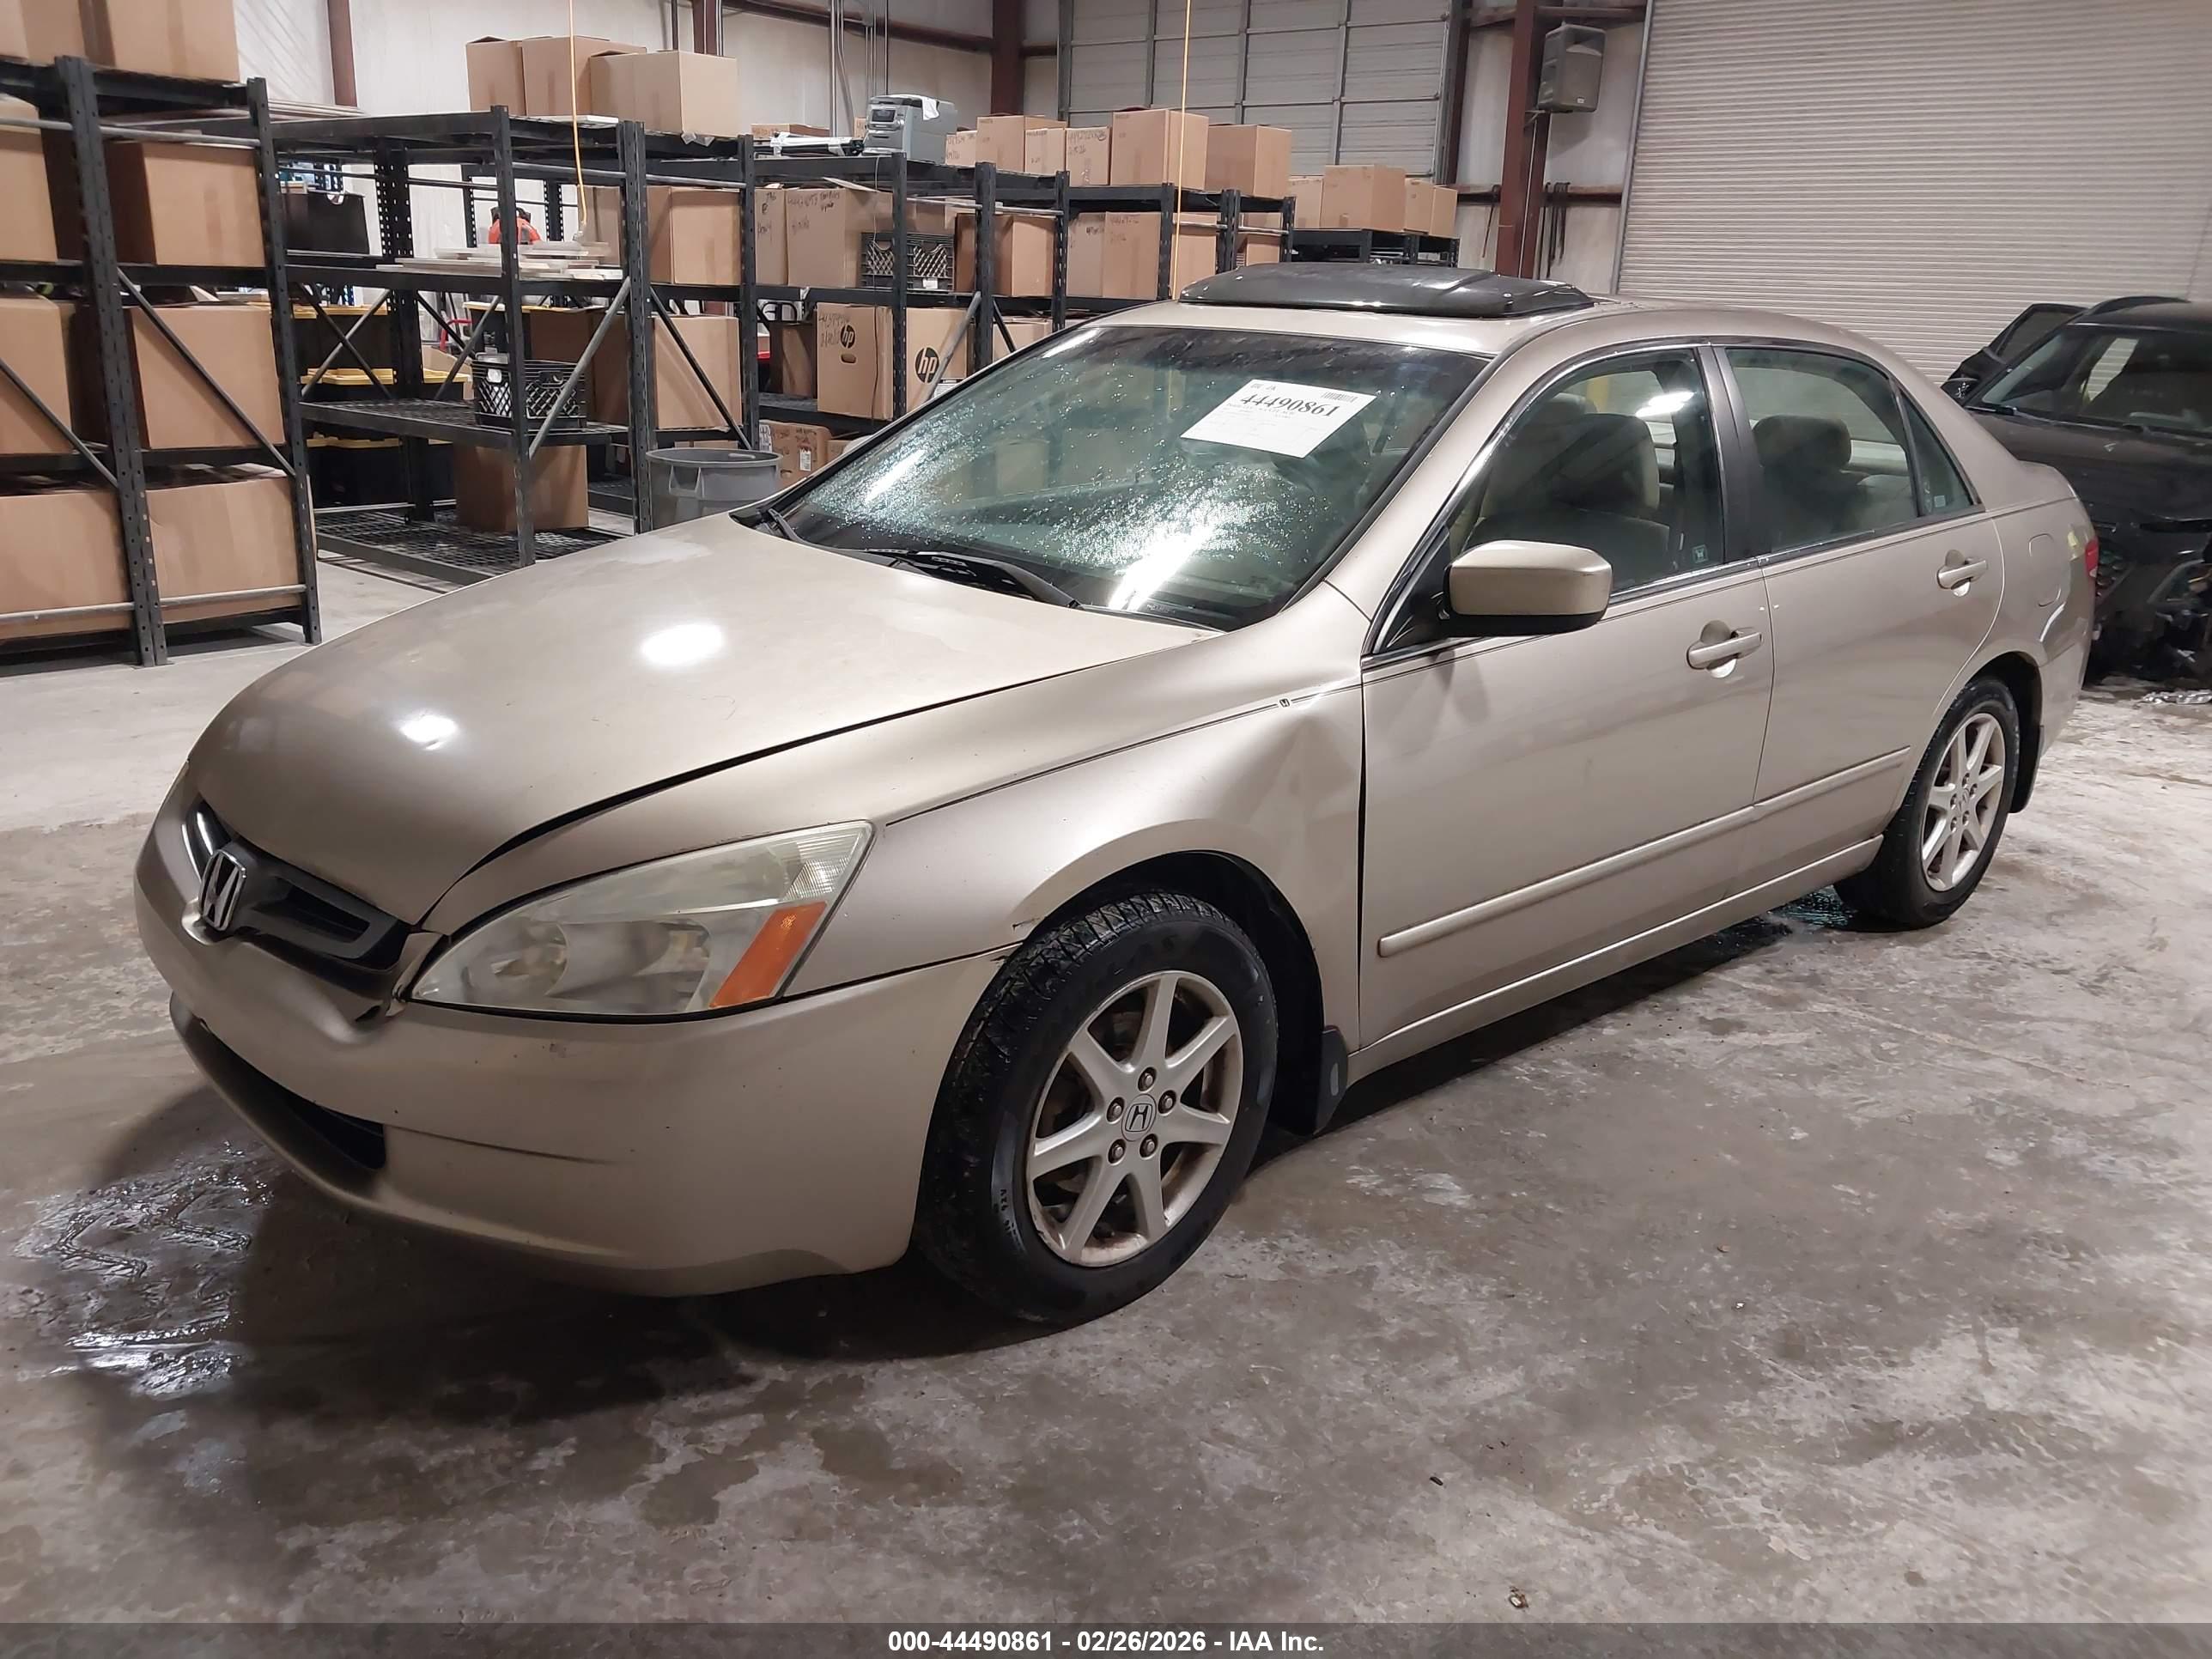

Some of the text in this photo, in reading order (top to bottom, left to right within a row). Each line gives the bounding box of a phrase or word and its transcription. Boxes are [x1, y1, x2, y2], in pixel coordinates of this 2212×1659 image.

[842, 324, 855, 349] hp
[916, 348, 939, 383] hp
[1240, 393, 1340, 417] 44490861
